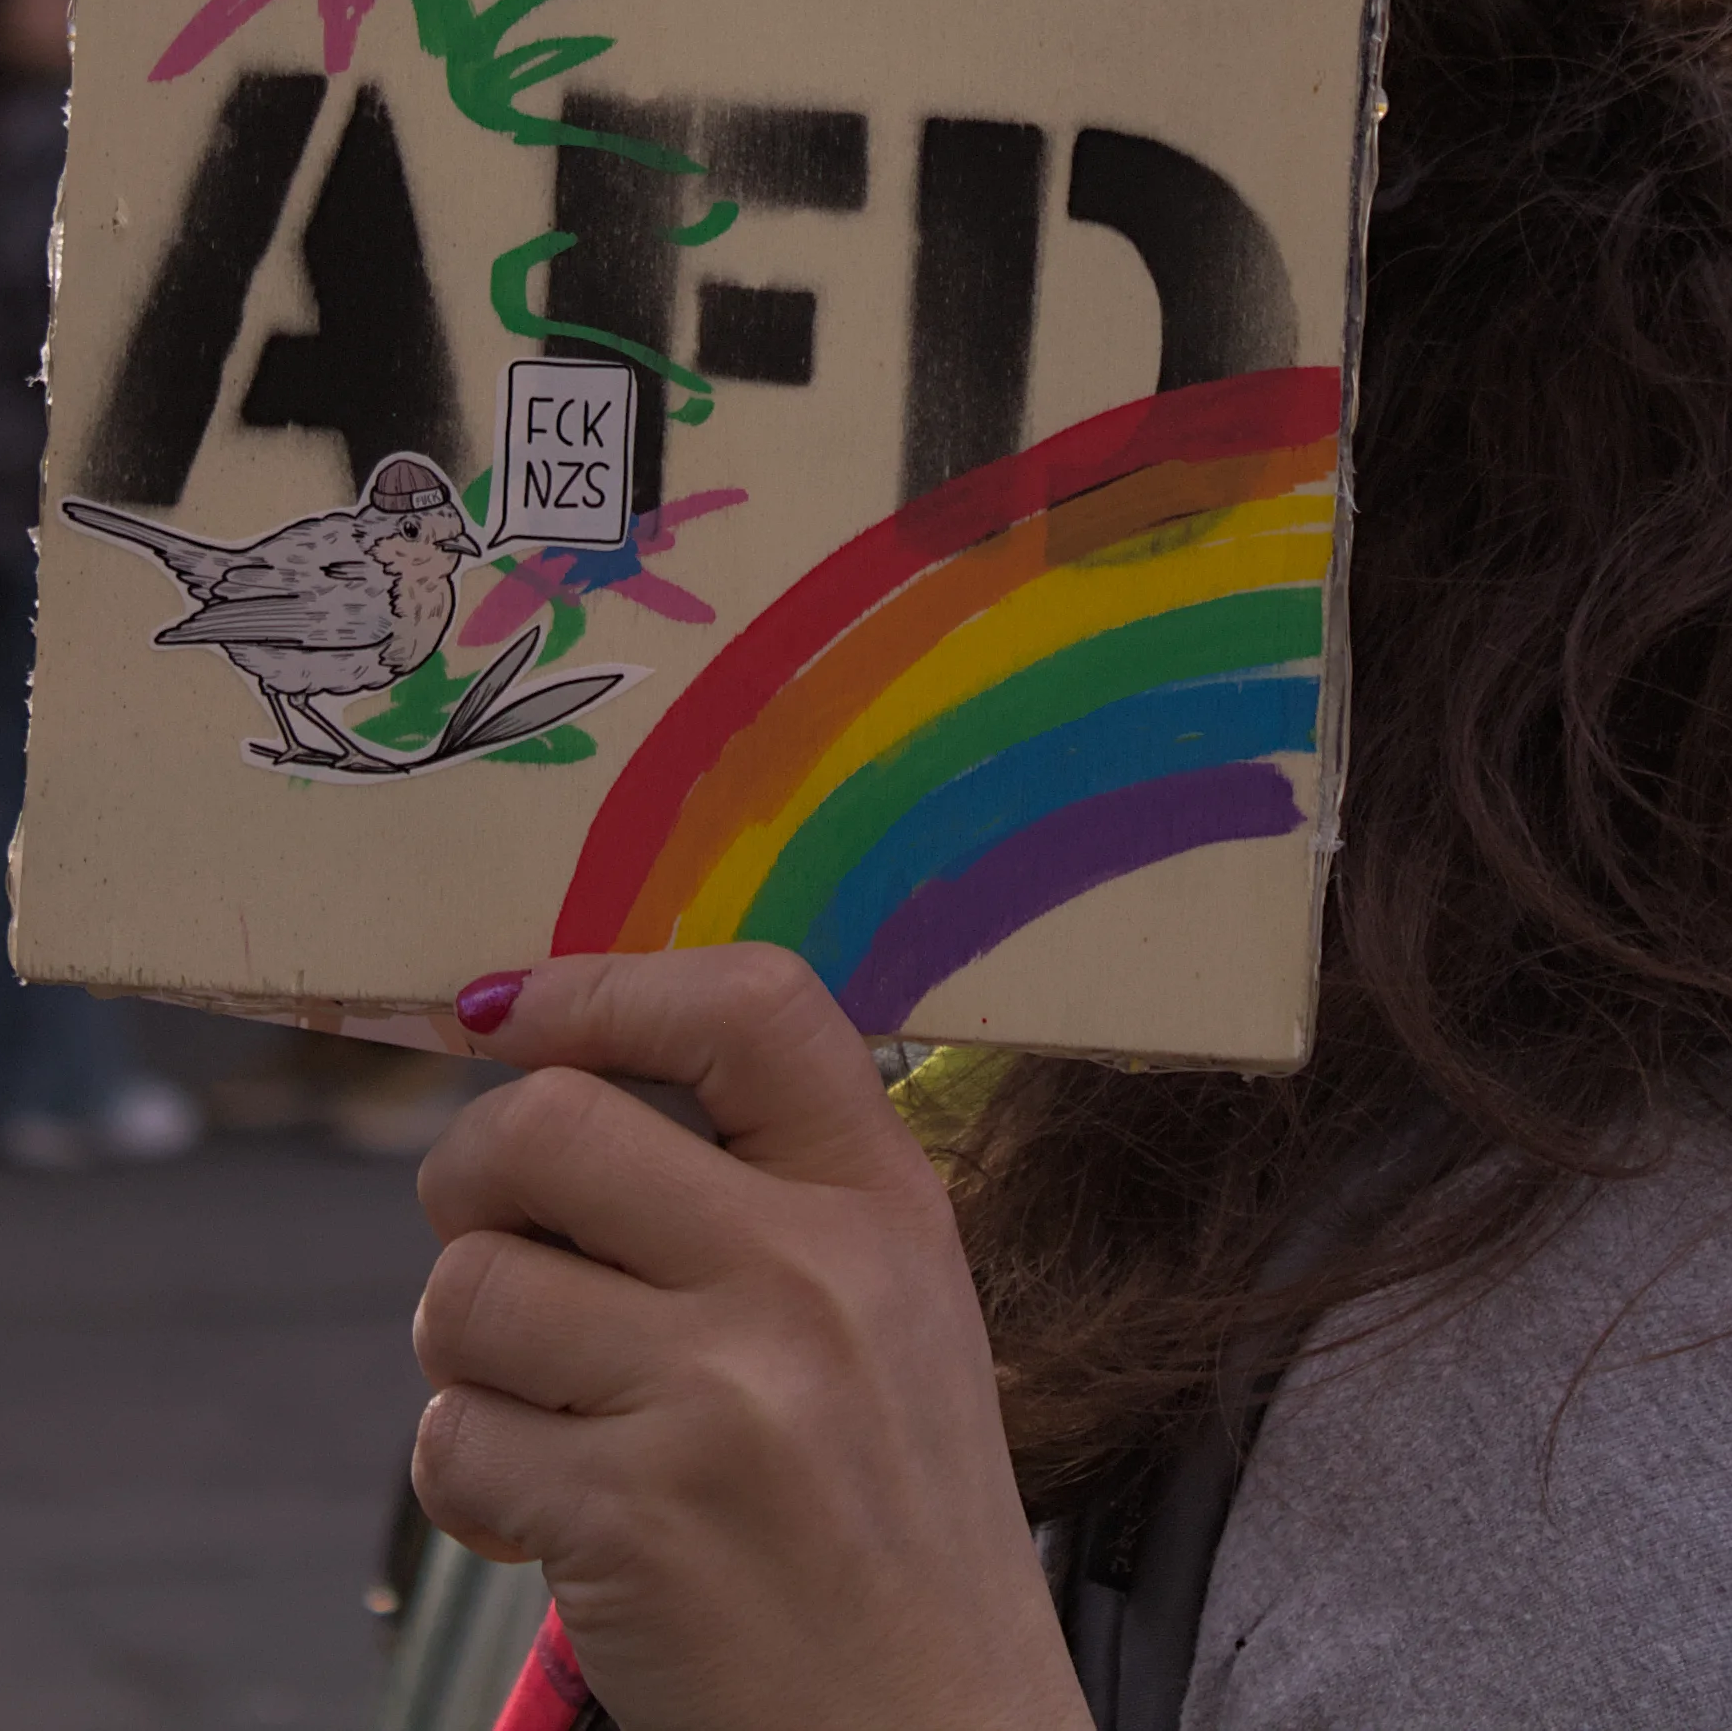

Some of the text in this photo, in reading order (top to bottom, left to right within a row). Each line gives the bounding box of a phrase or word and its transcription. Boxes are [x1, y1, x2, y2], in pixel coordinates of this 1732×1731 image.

[75, 73, 1301, 541] AFD
[527, 396, 612, 448] FCK
[524, 459, 610, 509] NZS
